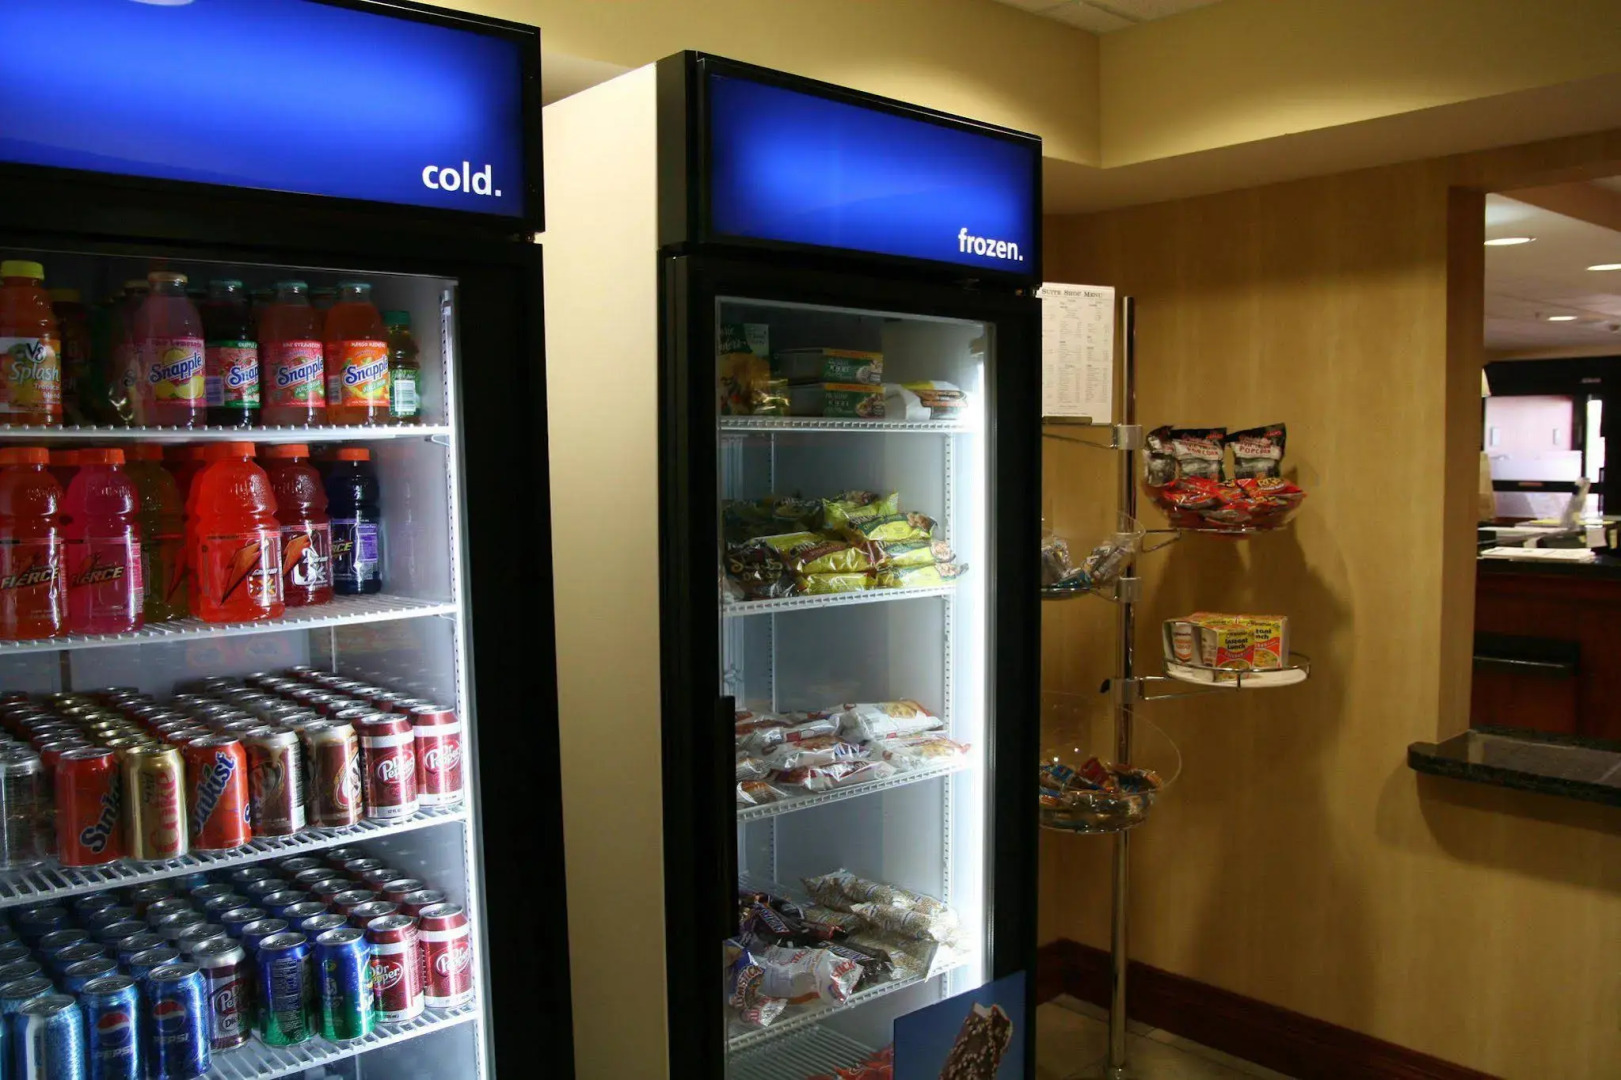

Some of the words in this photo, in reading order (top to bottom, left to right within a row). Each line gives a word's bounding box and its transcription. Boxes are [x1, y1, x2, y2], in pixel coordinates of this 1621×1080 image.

[422, 161, 501, 197] cold.
[958, 228, 1023, 261] frozen.
[9, 361, 59, 384] Splash
[149, 352, 202, 382] Snapple
[1, 567, 58, 589] FIERCE
